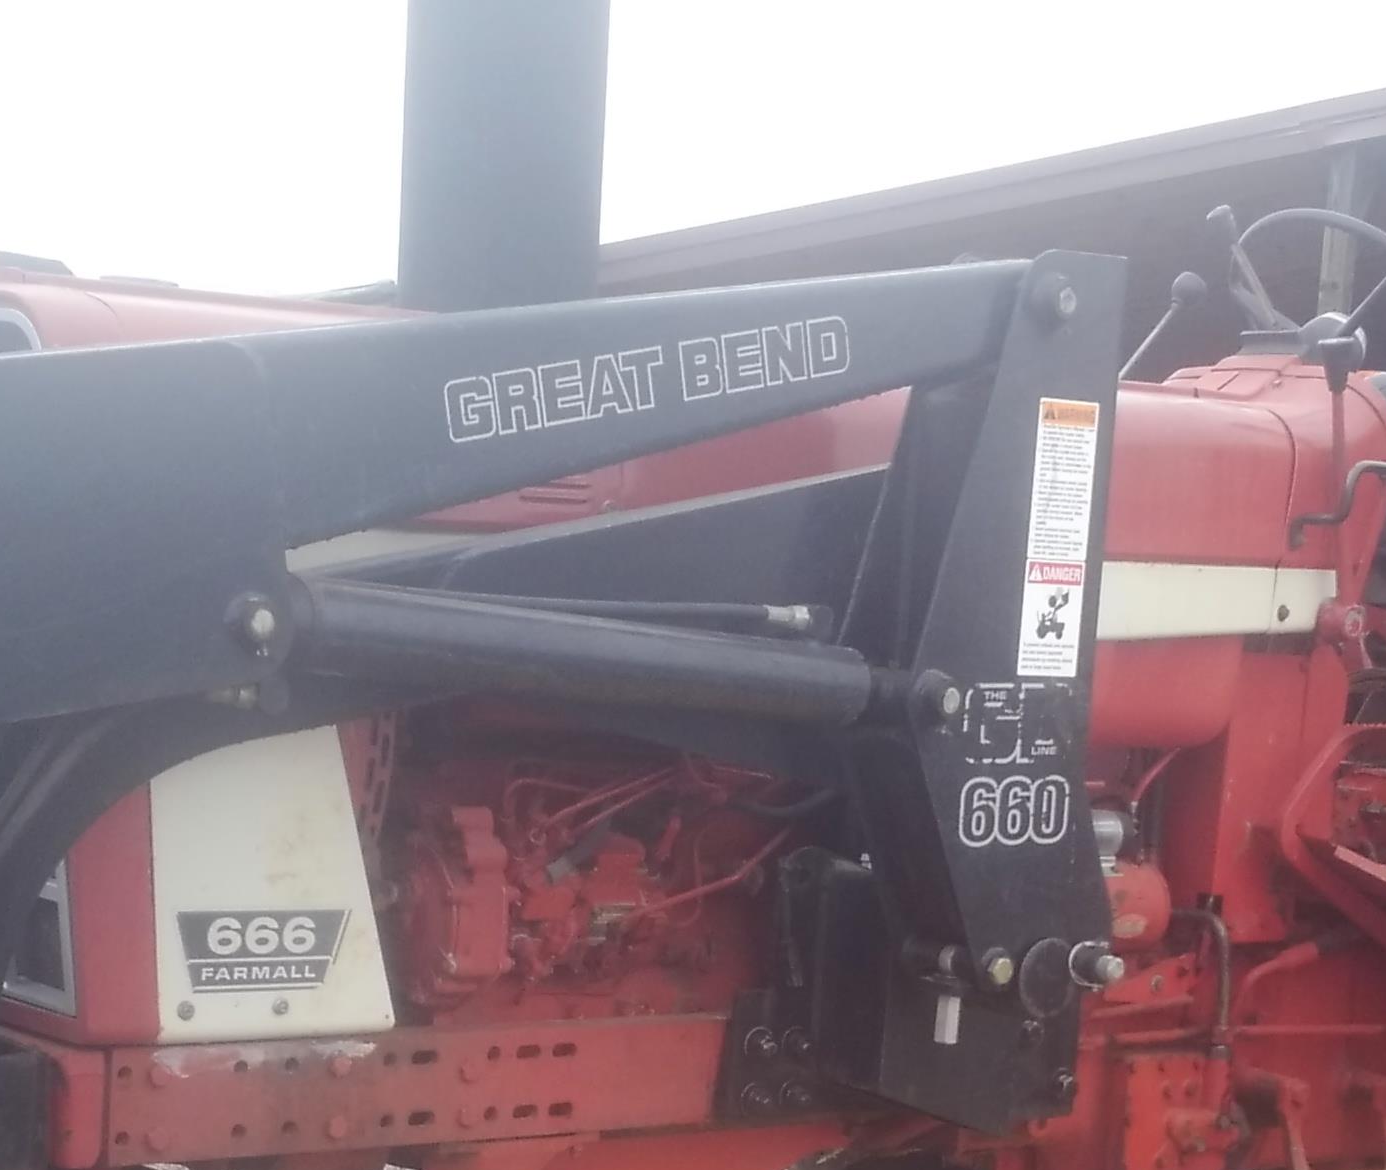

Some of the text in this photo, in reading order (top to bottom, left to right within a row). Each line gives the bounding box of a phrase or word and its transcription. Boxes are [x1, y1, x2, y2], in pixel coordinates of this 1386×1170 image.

[444, 315, 851, 443] GREAT BEND
[983, 690, 1008, 700] THE
[1030, 746, 1058, 756] LINE
[959, 774, 1070, 848] 660
[207, 916, 316, 956] 666
[200, 965, 317, 981] FARMALL
